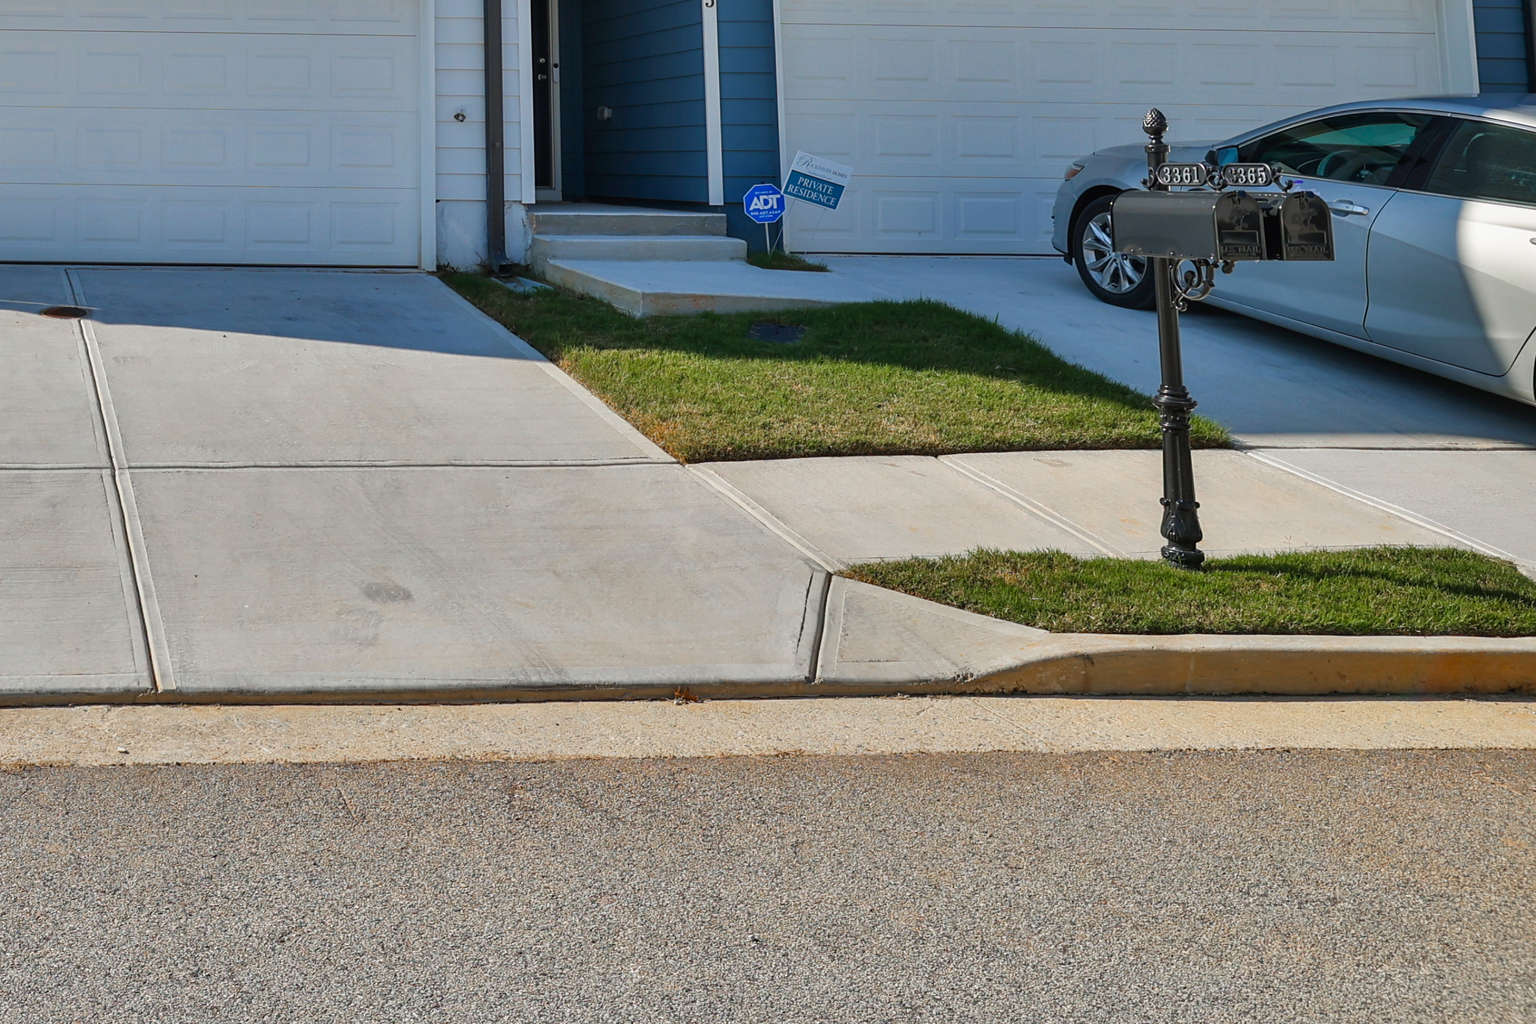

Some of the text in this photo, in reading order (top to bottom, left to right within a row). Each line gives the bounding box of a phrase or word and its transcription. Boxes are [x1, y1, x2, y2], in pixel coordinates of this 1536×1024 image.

[797, 155, 831, 173] ROCKHAVEN
[832, 170, 847, 178] HOMES
[1162, 166, 1200, 184] 3361
[1228, 166, 1267, 184] 3365
[788, 184, 836, 206] RESIDENCE
[798, 177, 834, 195] PRIVATE
[749, 194, 780, 211] ADT
[1237, 245, 1261, 253] MAIL
[1304, 246, 1329, 254] MAIL
